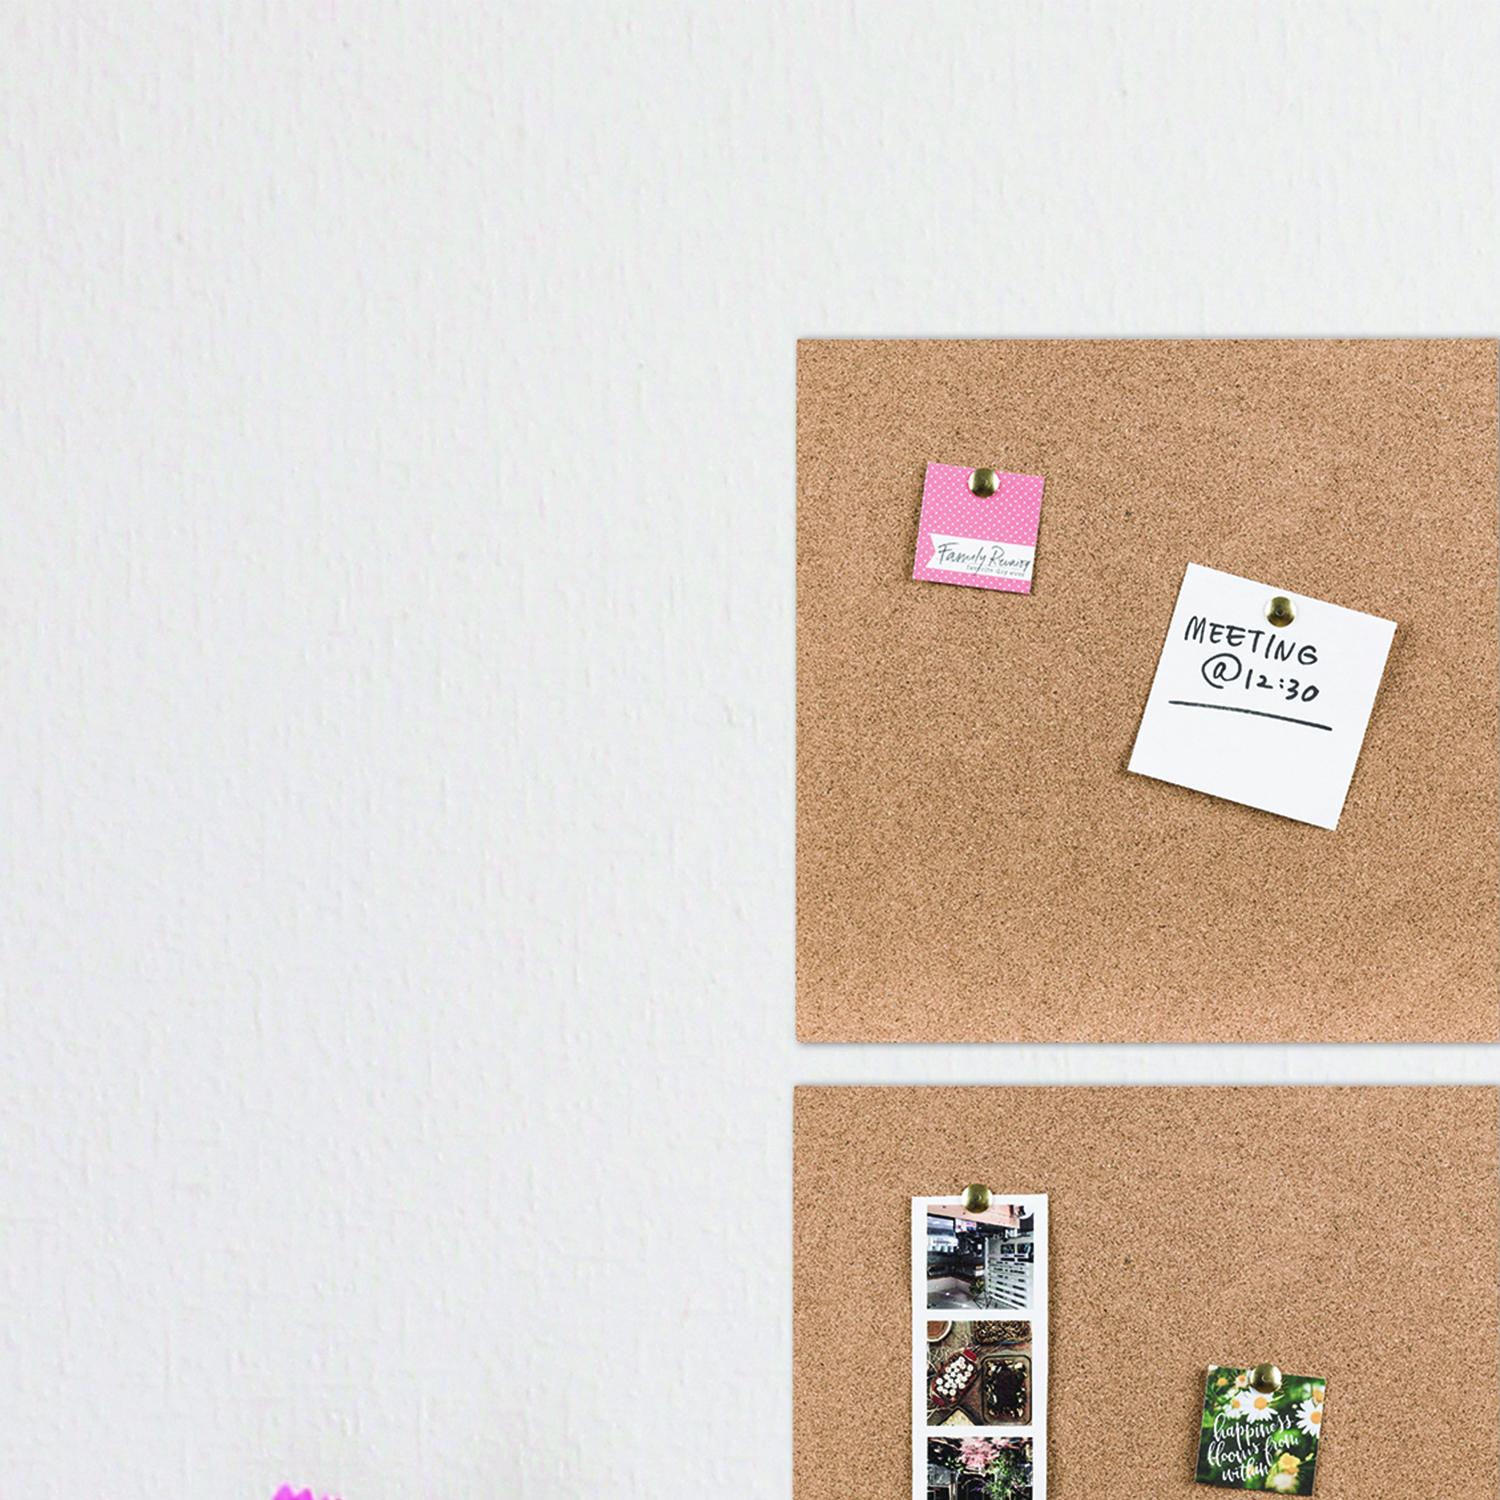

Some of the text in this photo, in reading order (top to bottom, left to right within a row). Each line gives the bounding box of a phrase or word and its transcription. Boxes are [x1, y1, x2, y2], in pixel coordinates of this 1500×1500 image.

[938, 542, 987, 576] Family
[1184, 615, 1318, 665] MEETING
[1201, 653, 1320, 702] @12:30
[1213, 1412, 1293, 1450] happiness
[1264, 1434, 1299, 1467] from
[1222, 1457, 1269, 1482] within
